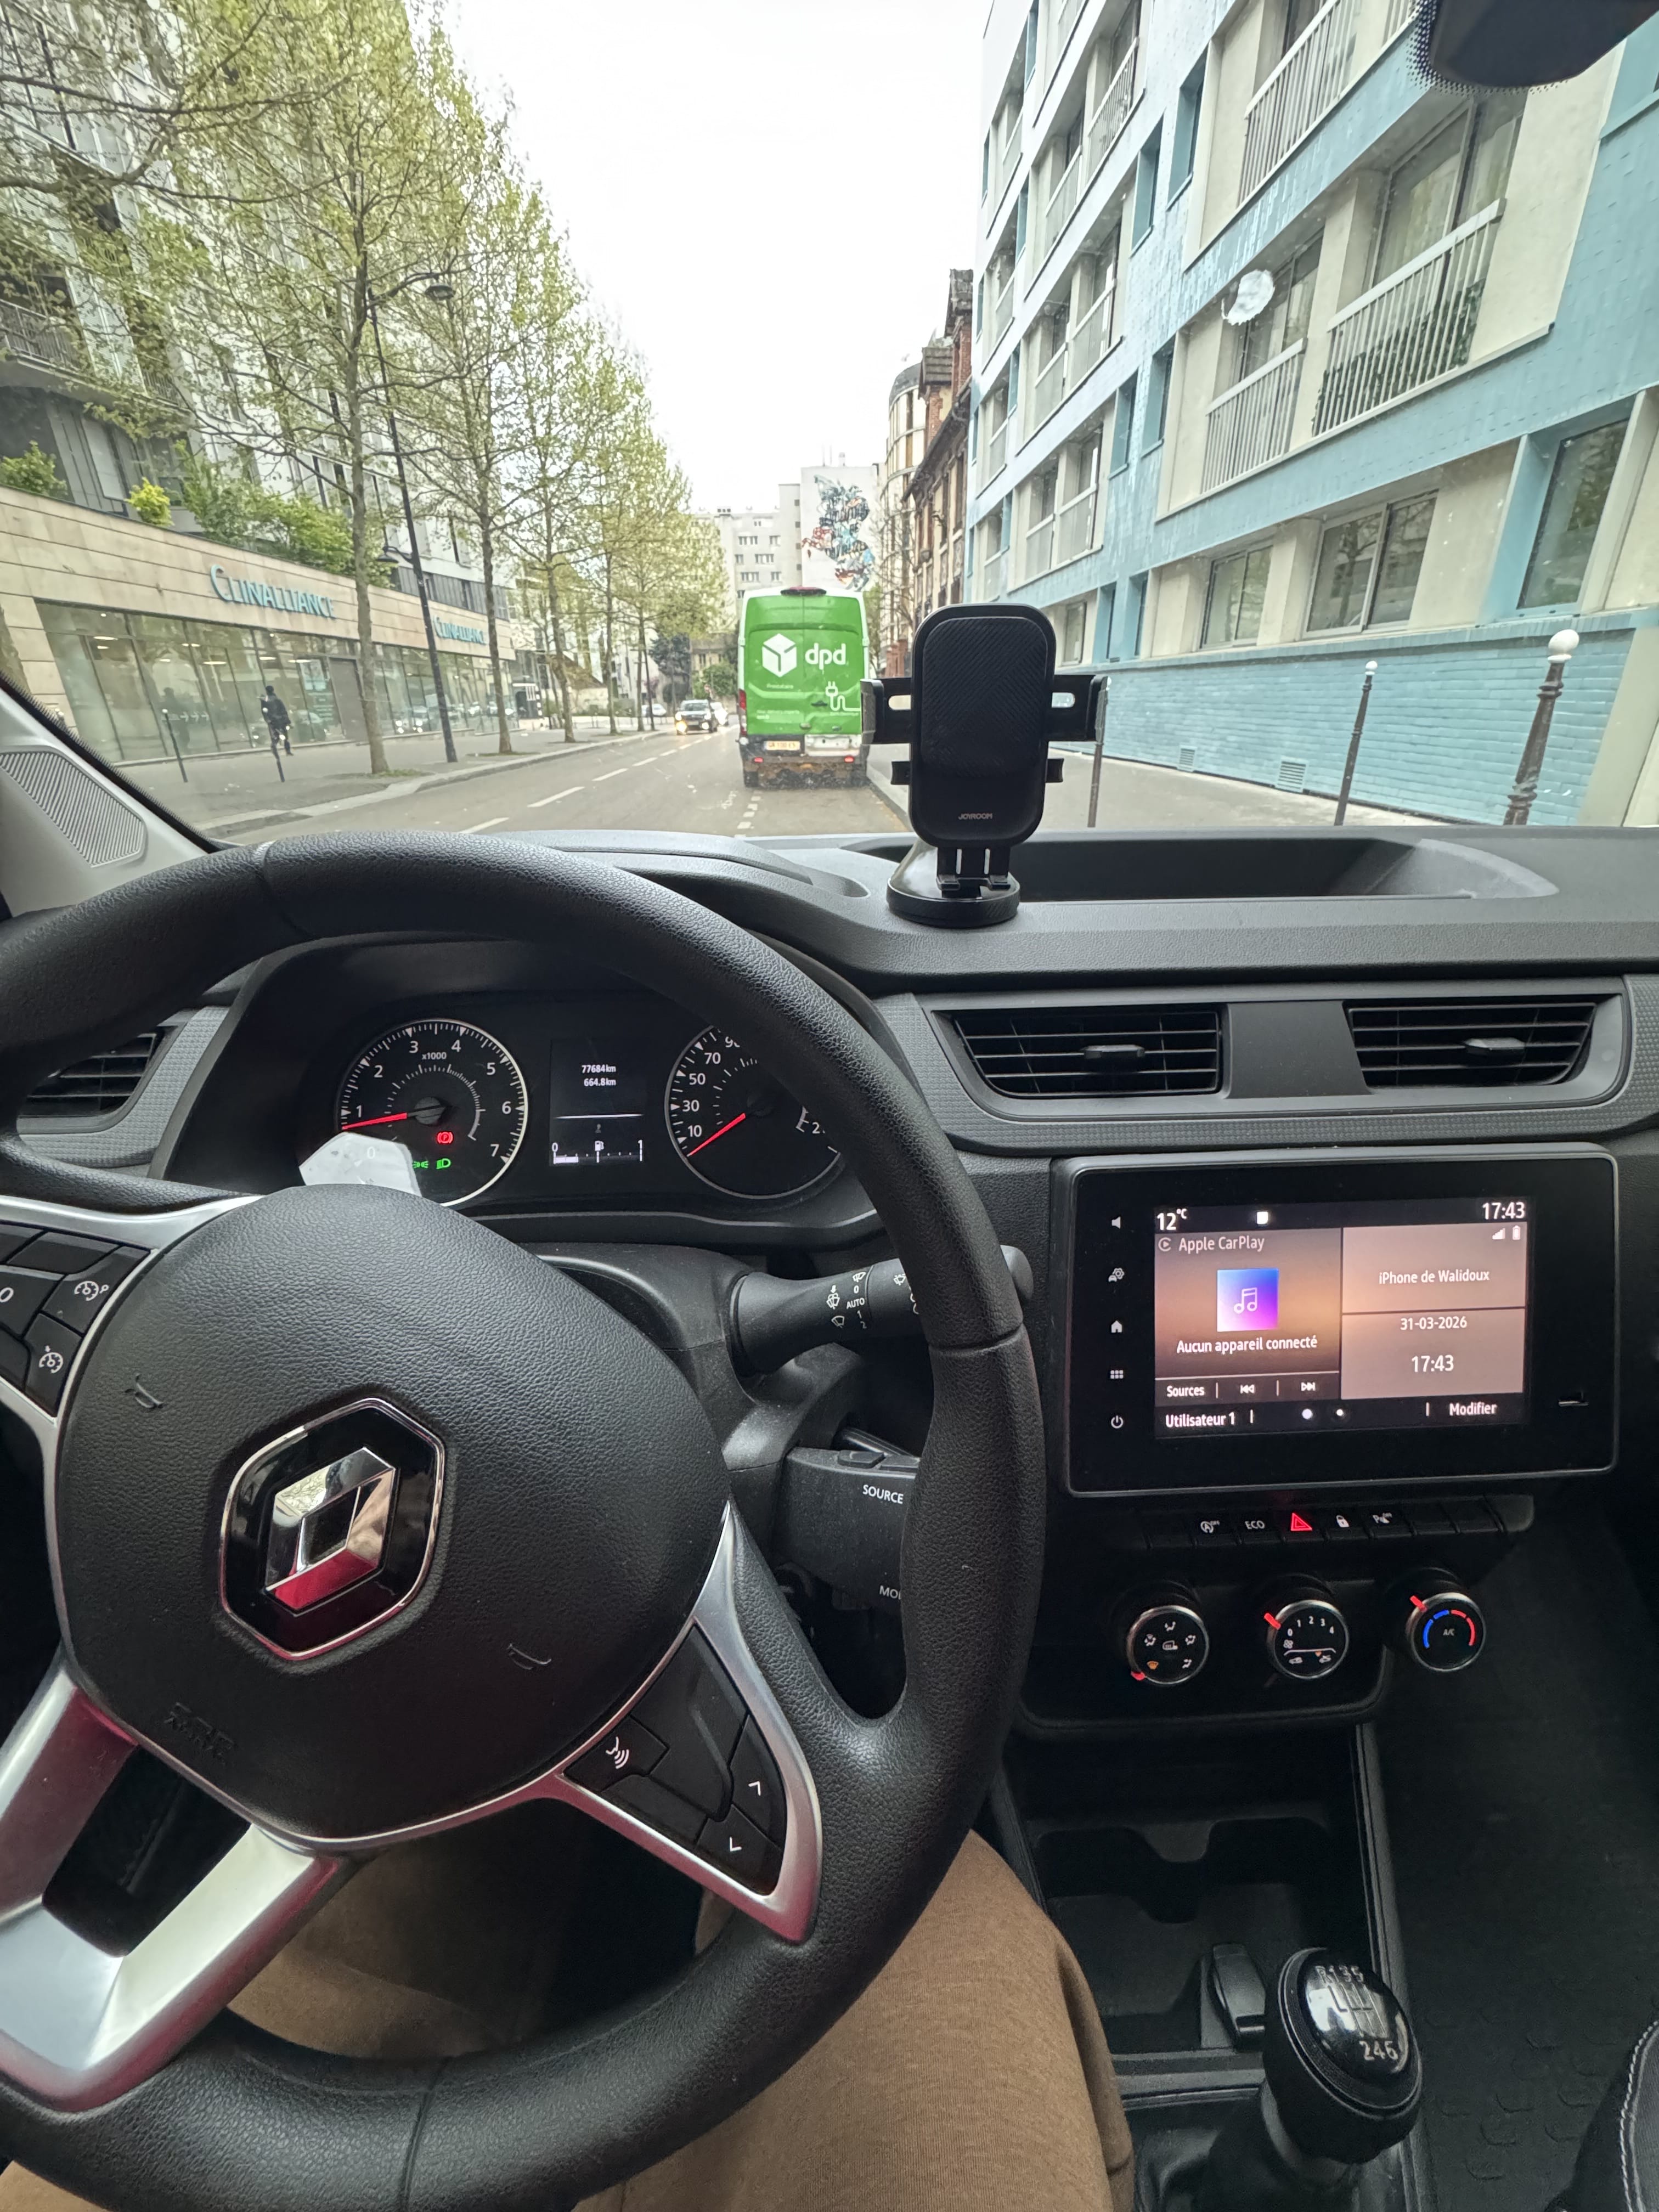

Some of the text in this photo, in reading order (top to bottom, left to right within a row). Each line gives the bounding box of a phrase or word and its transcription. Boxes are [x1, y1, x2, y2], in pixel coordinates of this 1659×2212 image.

[210, 564, 337, 619] CLINALLIANCE
[805, 642, 846, 670] dpd
[958, 812, 993, 821] JOYROOM
[409, 1041, 419, 1053] 3
[451, 1040, 461, 1052] 4
[421, 1052, 447, 1060] x1000
[704, 1052, 721, 1065] 70
[374, 1065, 383, 1077] 2
[487, 1062, 496, 1075] 5
[689, 1073, 706, 1085] 50
[356, 1105, 362, 1118] 1
[502, 1101, 511, 1114] 6
[682, 1099, 699, 1112] 30
[688, 1125, 702, 1137] 10
[367, 1147, 376, 1159] 0
[490, 1144, 499, 1157] 7
[552, 1142, 558, 1152] 0
[1482, 1201, 1525, 1220] 17:43
[1178, 1235, 1265, 1254] Apple CarPlay
[1379, 1268, 1490, 1284] iPhone de Walidoux
[854, 1285, 859, 1294] 0
[846, 1297, 865, 1310] AUTO
[857, 1310, 862, 1319] 1
[1400, 1316, 1468, 1330] 31-03-2026
[1177, 1335, 1318, 1355] Aucun appareil connecté
[1411, 1355, 1454, 1373] 17:43
[1166, 1385, 1205, 1397] Sources
[1449, 1401, 1498, 1417] Modifier
[1165, 1412, 1235, 1428] Utilisateur 1
[862, 1484, 904, 1504] SOURCE
[1245, 1520, 1265, 1530] ECO
[1287, 1628, 1293, 1637] 0
[1309, 1616, 1314, 1624] 2
[1321, 1618, 1325, 1627] 3
[1329, 1626, 1334, 1634] 4
[1316, 1966, 1333, 1984] R
[1339, 1966, 1352, 1982] 3
[1351, 1966, 1363, 1983] 5
[1359, 2040, 1398, 2061] 2 4 6
